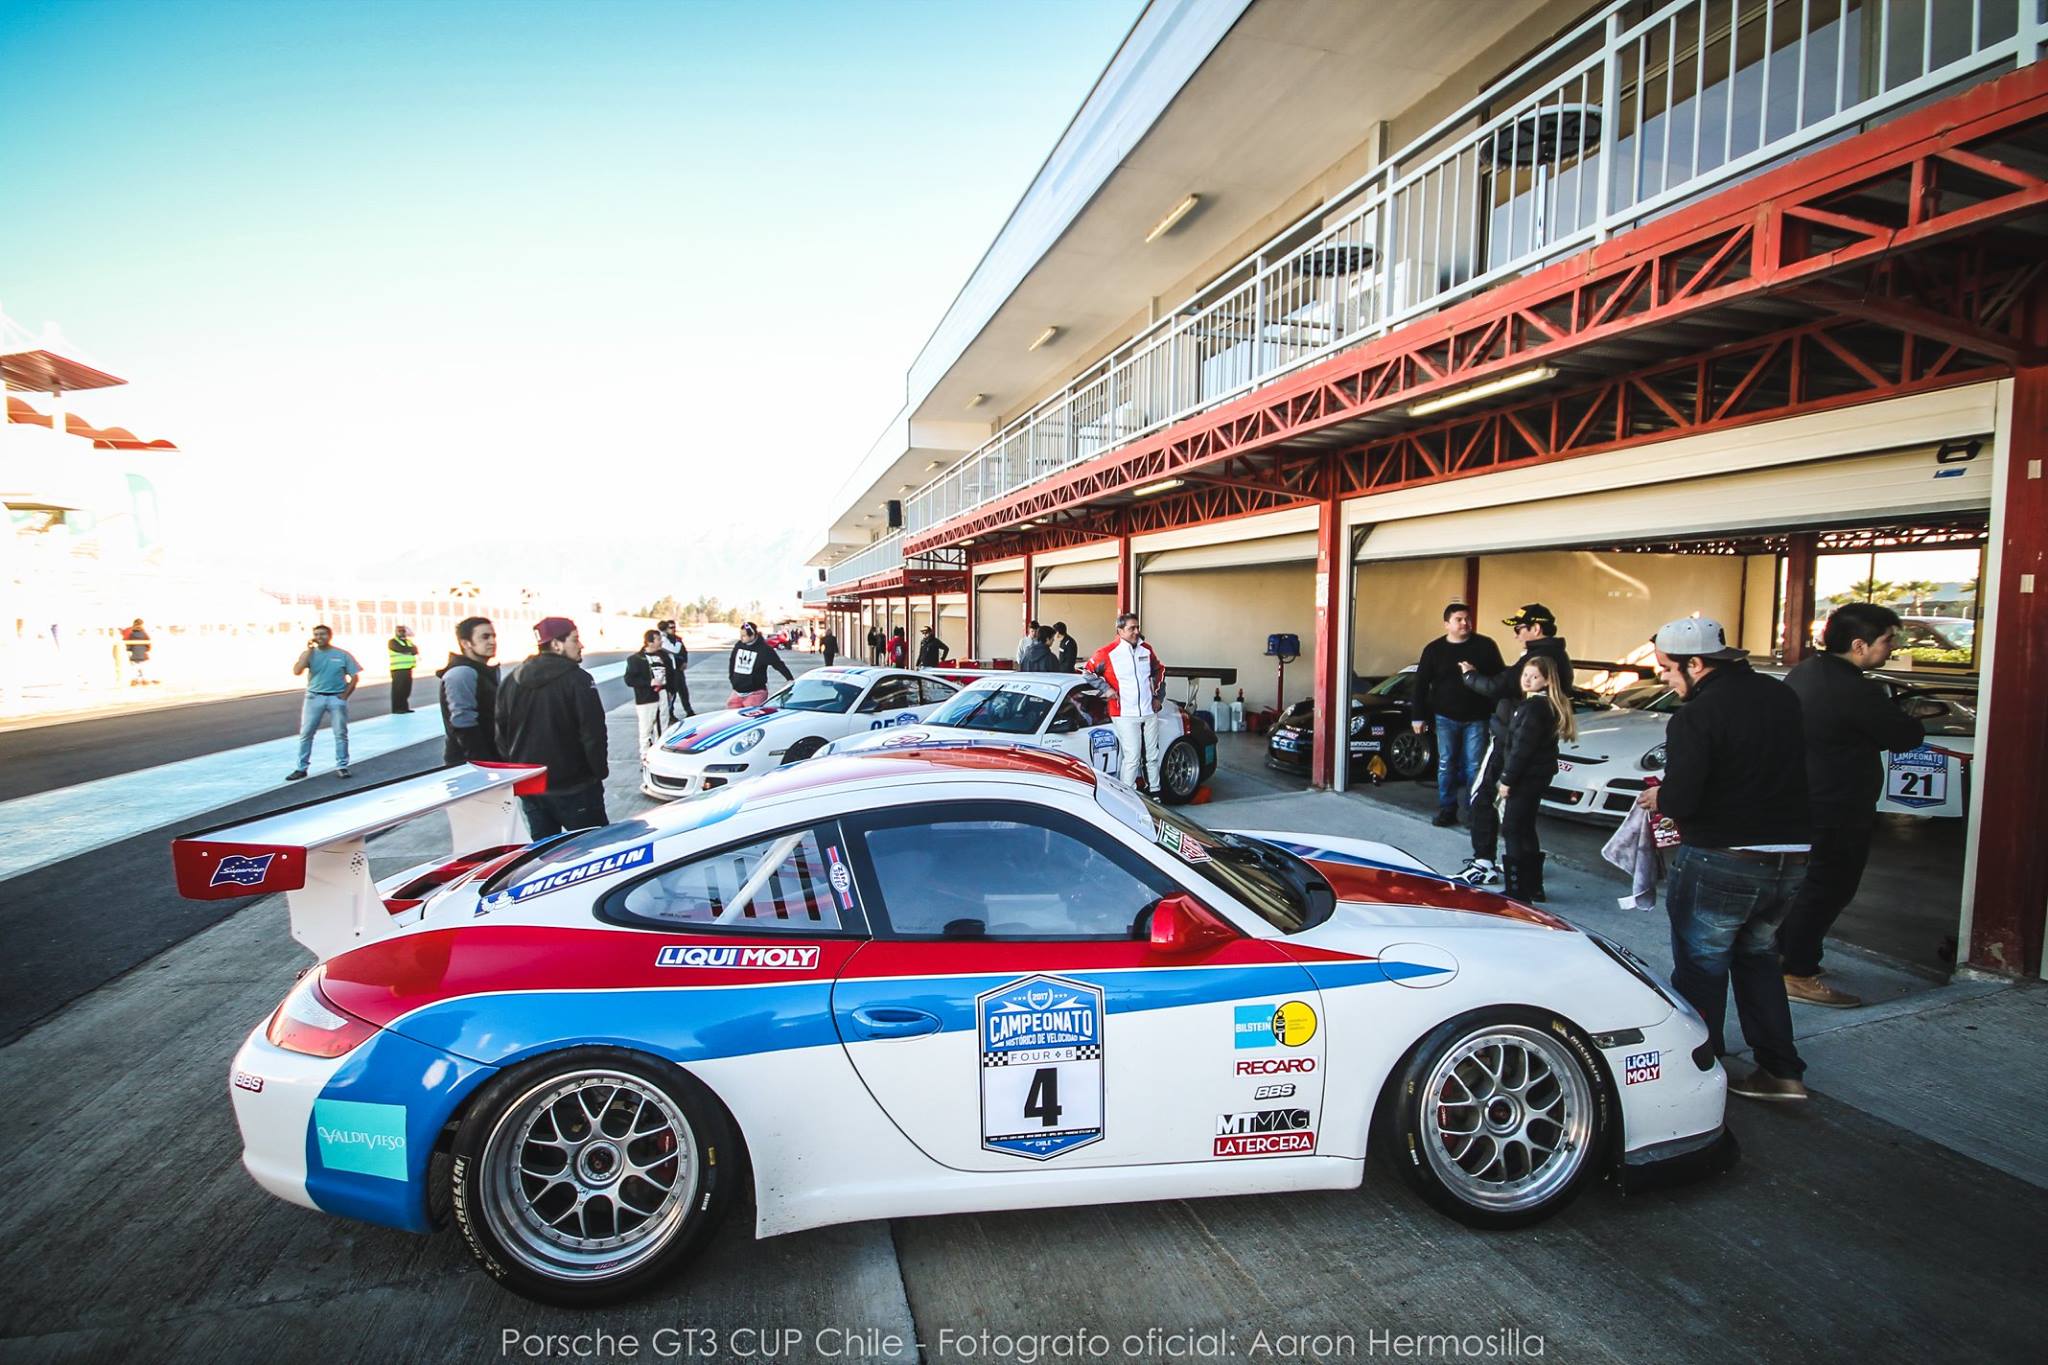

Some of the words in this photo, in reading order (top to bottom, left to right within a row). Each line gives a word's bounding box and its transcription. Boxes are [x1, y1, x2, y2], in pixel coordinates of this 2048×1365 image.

[1102, 753, 1109, 772] 7
[1901, 772, 1933, 796] 21
[1162, 823, 1180, 847] TAG
[520, 848, 646, 897] MICHELIN
[662, 948, 737, 967] LIQUI
[741, 949, 817, 966] MOLY
[1032, 992, 1048, 1001] 2017
[990, 1010, 1093, 1043] CAMPEONATO
[1235, 1022, 1272, 1033] BILSTEIN
[1038, 1033, 1045, 1044] DE
[1046, 1032, 1078, 1043] VELOCIDAD
[1011, 1050, 1051, 1062] FOUR
[1065, 1049, 1074, 1059] B
[1571, 1036, 1601, 1082] MICHELIN
[1627, 1052, 1658, 1070] LIQUI
[1236, 1058, 1316, 1075] RECARO
[1627, 1066, 1659, 1084] MOLY
[236, 1073, 263, 1092] BBS
[1254, 1083, 1296, 1100] BBS
[1024, 1067, 1062, 1127] 4
[318, 1126, 406, 1150] VALDIVIESO
